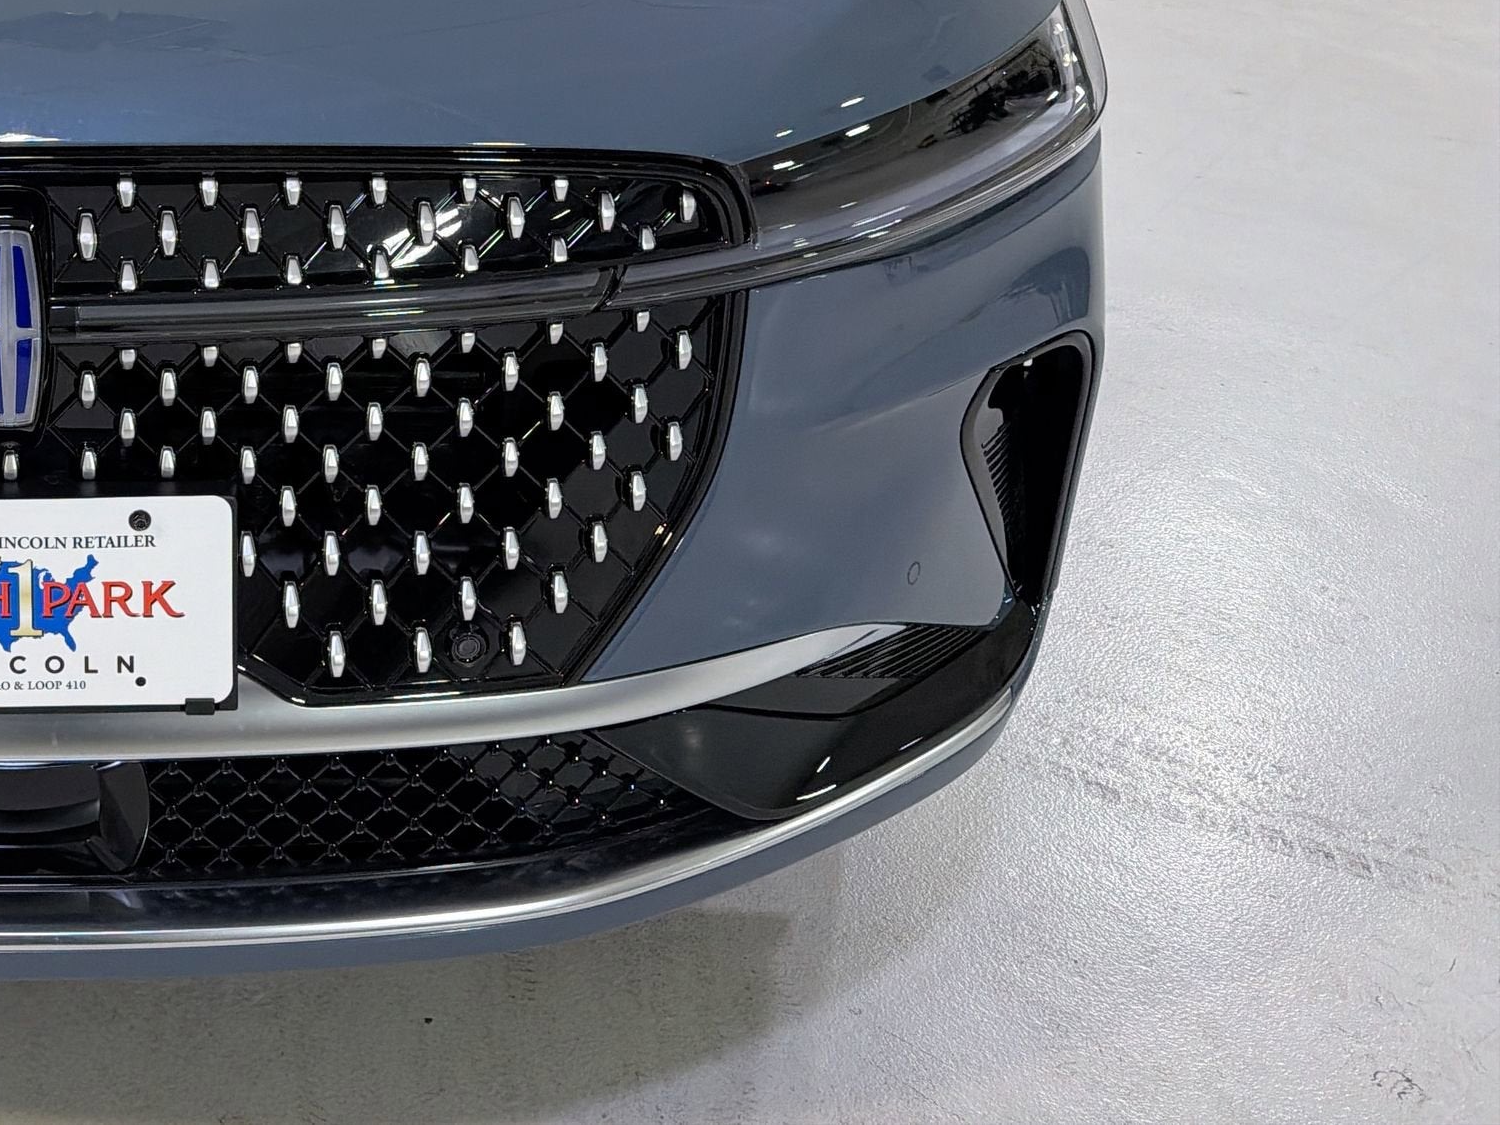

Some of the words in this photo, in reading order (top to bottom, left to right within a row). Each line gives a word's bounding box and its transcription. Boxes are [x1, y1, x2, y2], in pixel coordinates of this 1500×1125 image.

[72, 535, 156, 549] RETAILER
[41, 580, 185, 619] PARK
[13, 681, 25, 691] &
[27, 680, 63, 690] LOOP
[65, 680, 87, 690] 410
